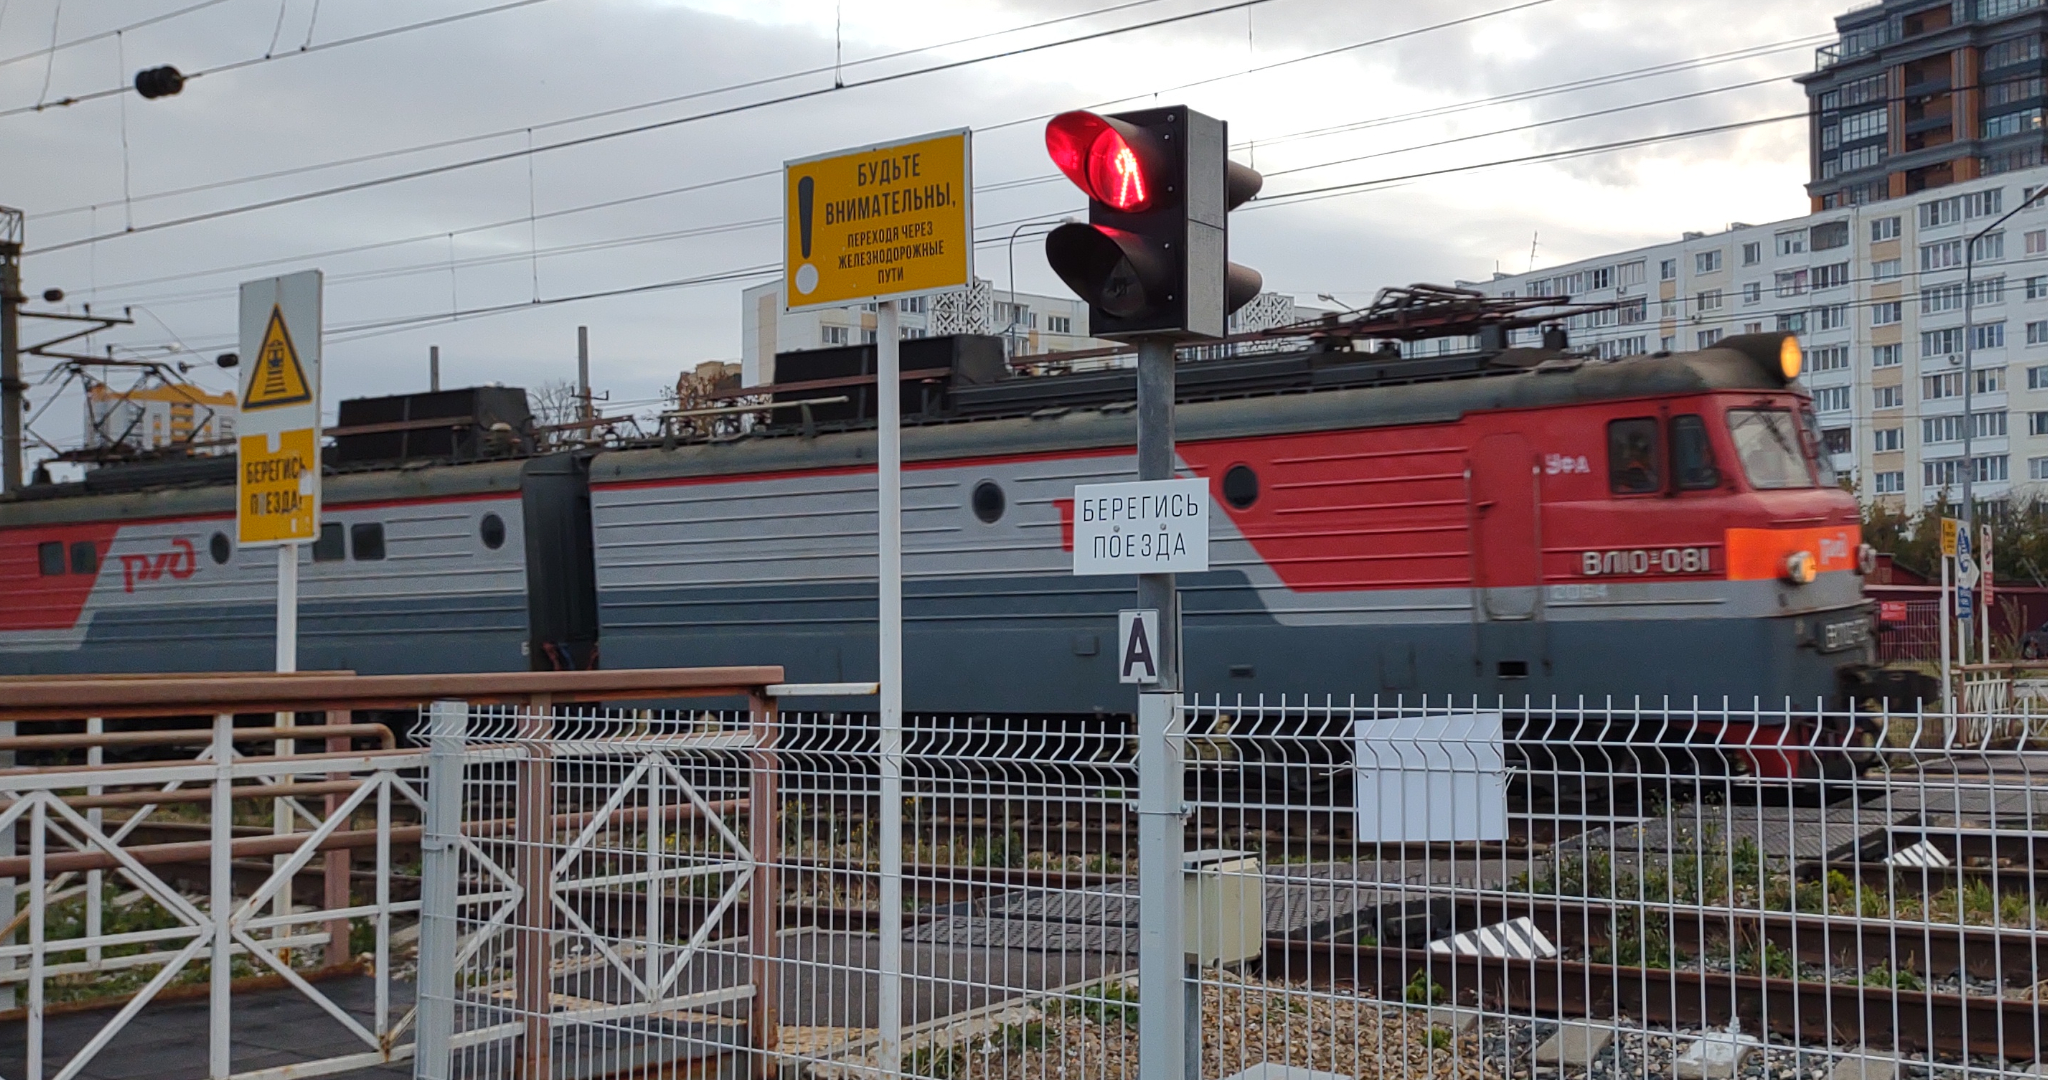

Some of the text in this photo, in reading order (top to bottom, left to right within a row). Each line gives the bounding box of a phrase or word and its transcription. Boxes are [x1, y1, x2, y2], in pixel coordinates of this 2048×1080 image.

[857, 153, 921, 186] БУДЬТЕ
[825, 182, 956, 225] ВНИМАТЕЛЬНЫ,
[847, 221, 933, 248] ПЕРЕХОДЯ ЧЕРЕЗ
[838, 240, 944, 269] ЖЕЛЕЗНОДОРОЖНЫЕ
[878, 267, 904, 284] ПУТИ
[1083, 493, 1199, 522] БЕРЕГИСЬ
[1094, 532, 1186, 561] ПОЕЗДА
[1122, 617, 1156, 677] А
